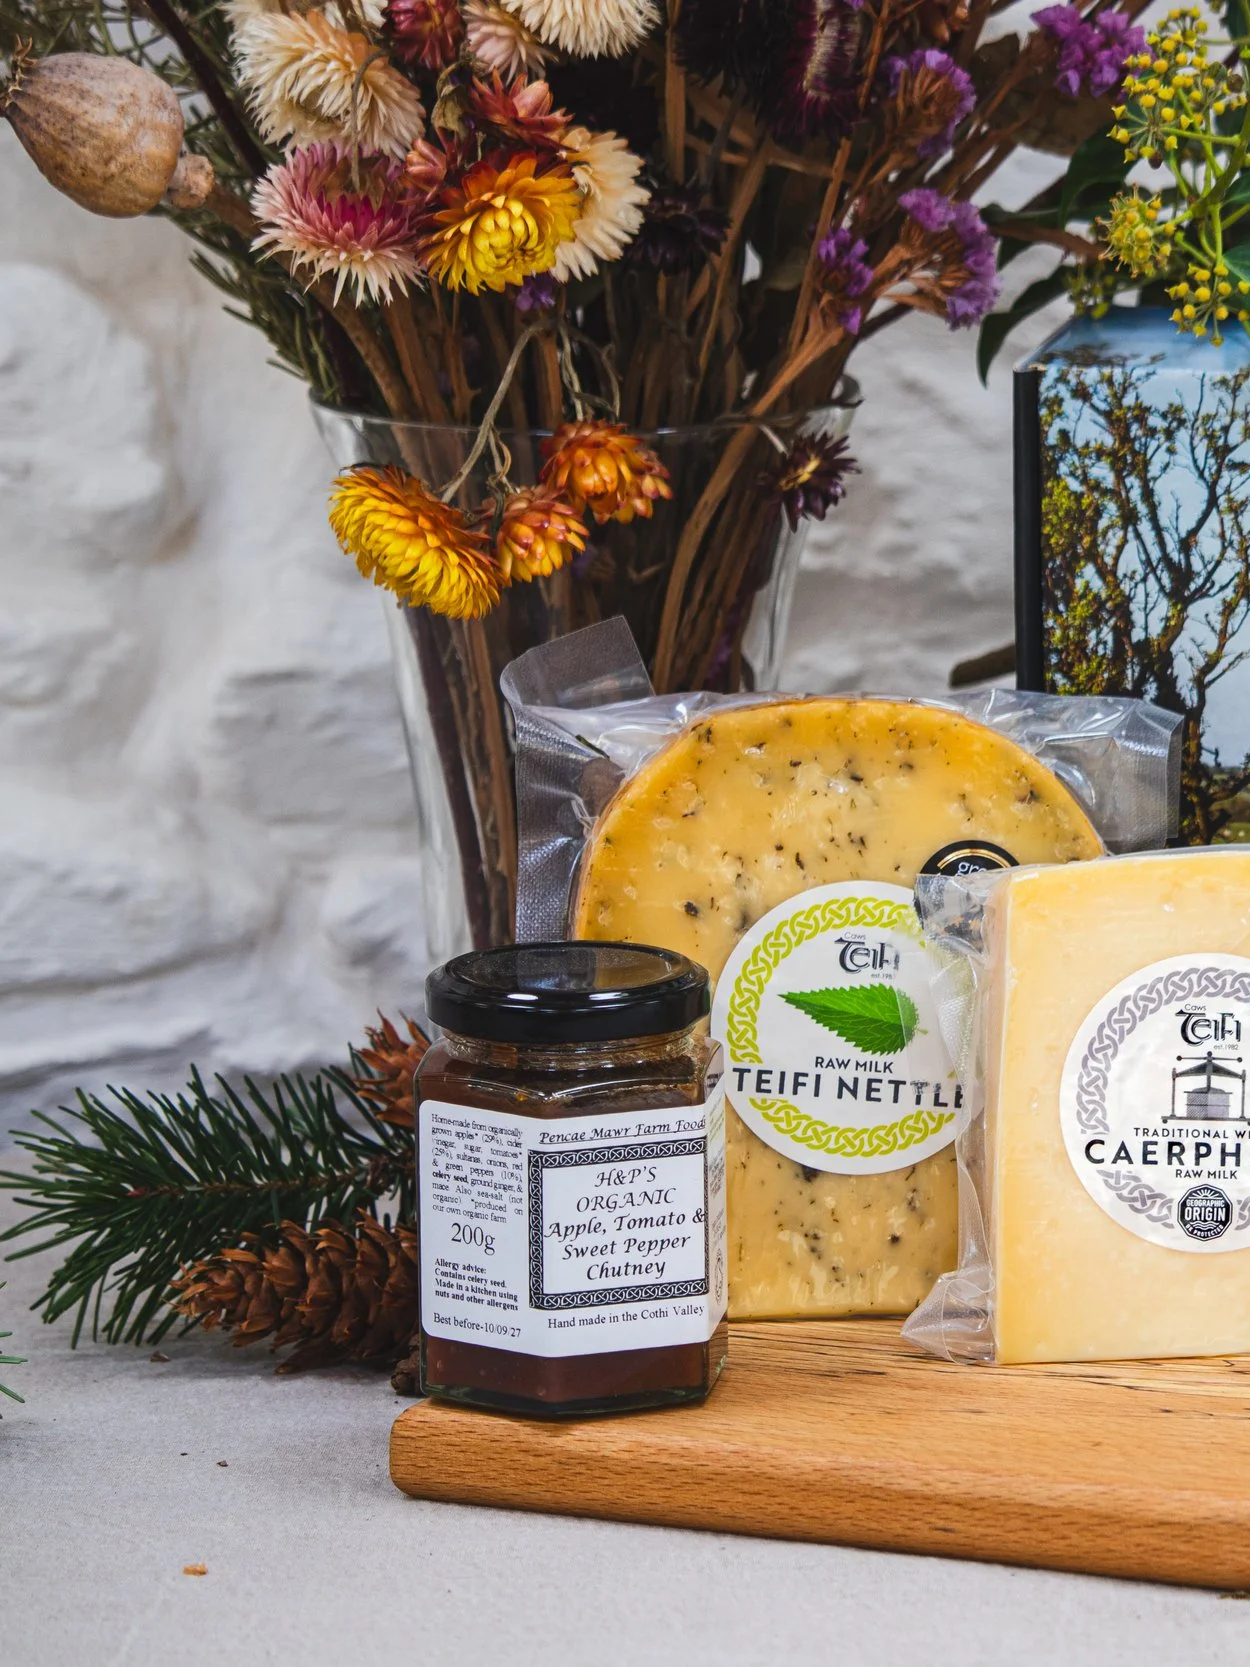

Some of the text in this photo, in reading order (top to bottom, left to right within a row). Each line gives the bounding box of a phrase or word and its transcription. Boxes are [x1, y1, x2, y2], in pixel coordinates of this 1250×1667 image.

[844, 931, 866, 940] Caws
[1184, 1003, 1207, 1011] Caws
[815, 1055, 893, 1074] RAW MILK
[732, 1067, 821, 1098] TEIFI
[432, 1113, 523, 1139] Home-made from organically
[539, 1131, 586, 1144] Pencae
[590, 1127, 631, 1140] Mawr
[633, 1123, 670, 1137] Farm
[1133, 1127, 1229, 1140] TRADITIONAL
[432, 1127, 452, 1136] grown
[507, 1140, 523, 1149] cider
[432, 1158, 439, 1167] &
[445, 1163, 463, 1172] green
[512, 1162, 523, 1171] red
[1176, 1168, 1238, 1180] RAW MILK
[432, 1171, 451, 1182] celery
[471, 1178, 493, 1187] ground
[517, 1185, 523, 1193] &
[456, 1185, 472, 1195] Also
[477, 1191, 503, 1201] sea-salt
[509, 1194, 523, 1204] (not
[576, 1188, 677, 1213] ORGANIC
[1186, 1199, 1225, 1207] GEOGRAPHIC
[432, 1204, 507, 1223] our own organic farm
[1184, 1206, 1226, 1221] ORIGIN
[544, 1216, 607, 1243] Apple,
[614, 1211, 686, 1232] Tomato
[692, 1208, 706, 1224] &
[451, 1222, 495, 1256] 200g
[562, 1235, 691, 1261] Sweet Pepper
[435, 1258, 486, 1274] Allergy advice:
[587, 1261, 666, 1280] Chutney
[435, 1268, 466, 1281] Contains
[467, 1275, 488, 1286] celery
[435, 1278, 454, 1289] Made
[457, 1282, 463, 1291] in
[471, 1285, 497, 1297] kitchen
[499, 1292, 518, 1302] using
[435, 1290, 519, 1311] nuts and other allergens
[434, 1312, 451, 1325] Best
[548, 1304, 705, 1329] Hand made in the Cothi Valley
